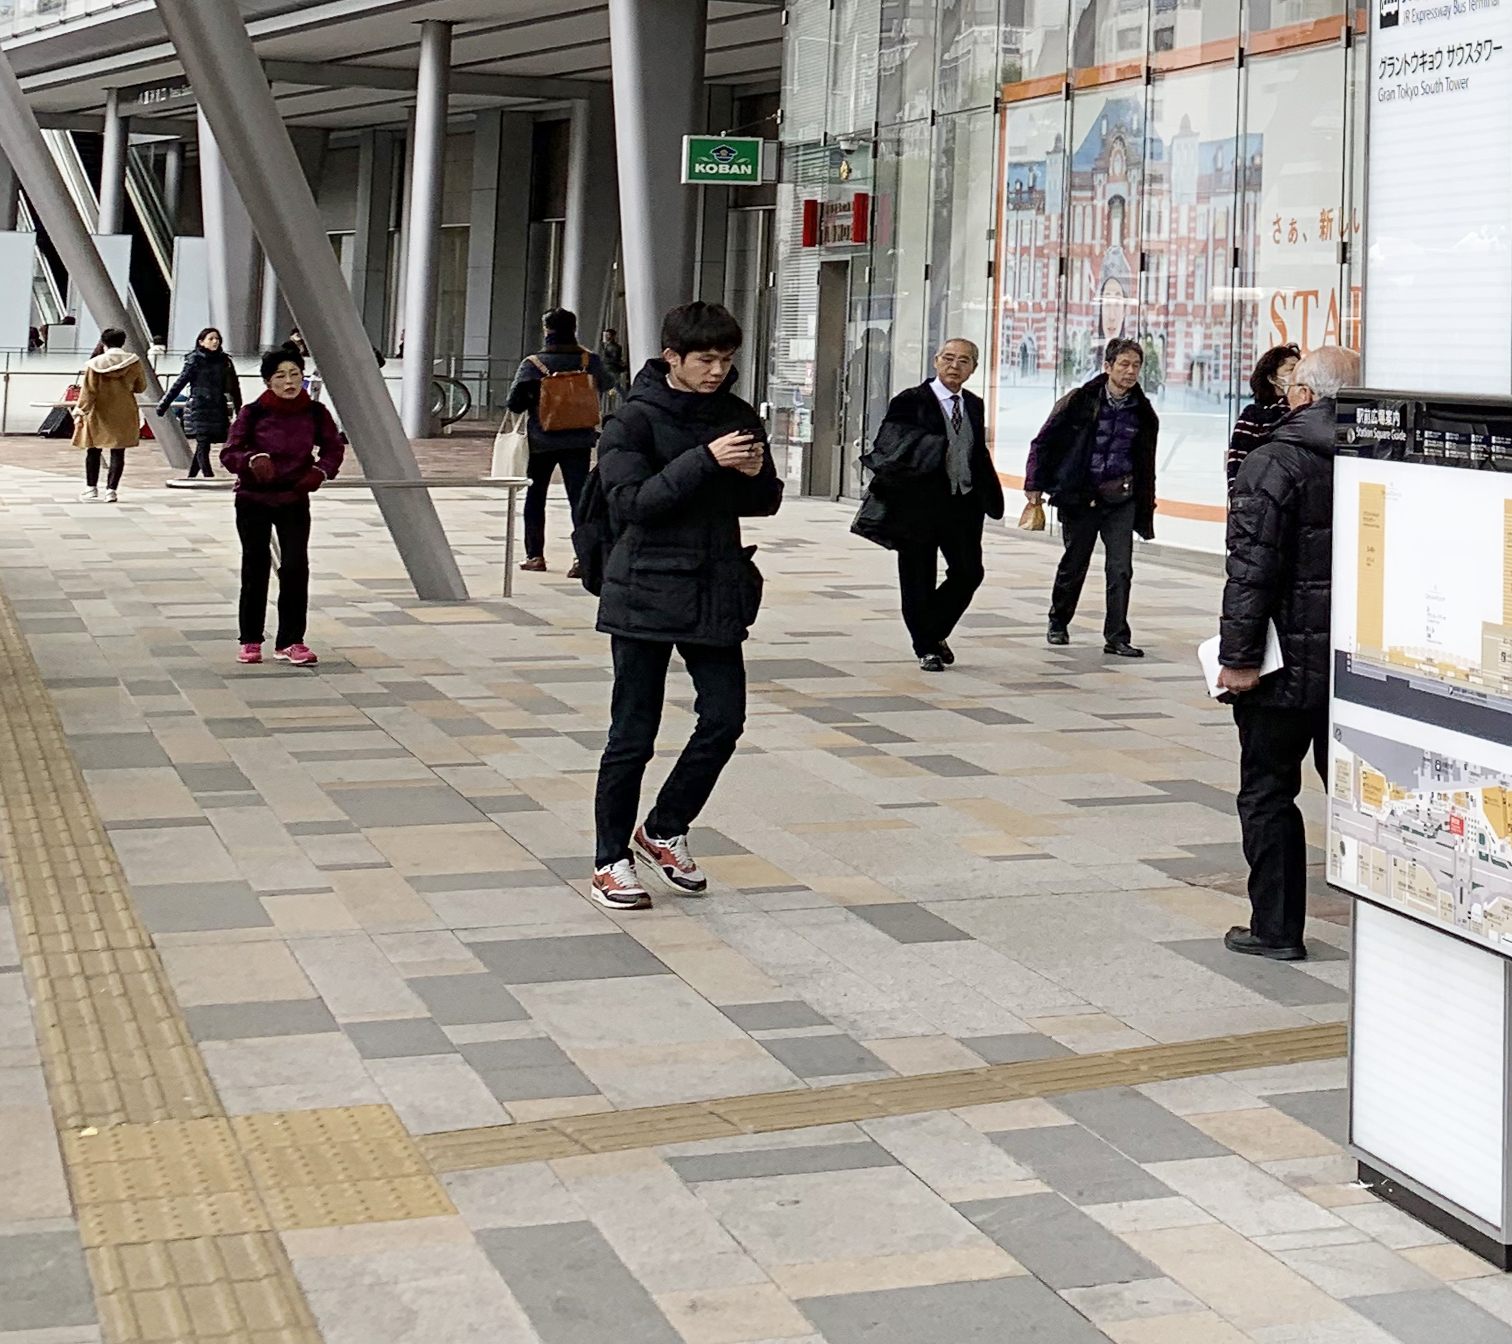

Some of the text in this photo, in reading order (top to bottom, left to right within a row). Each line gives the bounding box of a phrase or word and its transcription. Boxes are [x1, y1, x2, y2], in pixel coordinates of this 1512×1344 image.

[1402, 10, 1410, 25] JR
[1412, 3, 1451, 25] Expressway
[1453, 0, 1466, 14] Bus
[1379, 39, 1503, 80] グラントウキョウ サウスタワー
[1378, 76, 1469, 102] Gran Tokyo South Tower
[694, 162, 752, 175] KOBAN
[1355, 426, 1373, 438] Station
[1374, 427, 1390, 441] Square
